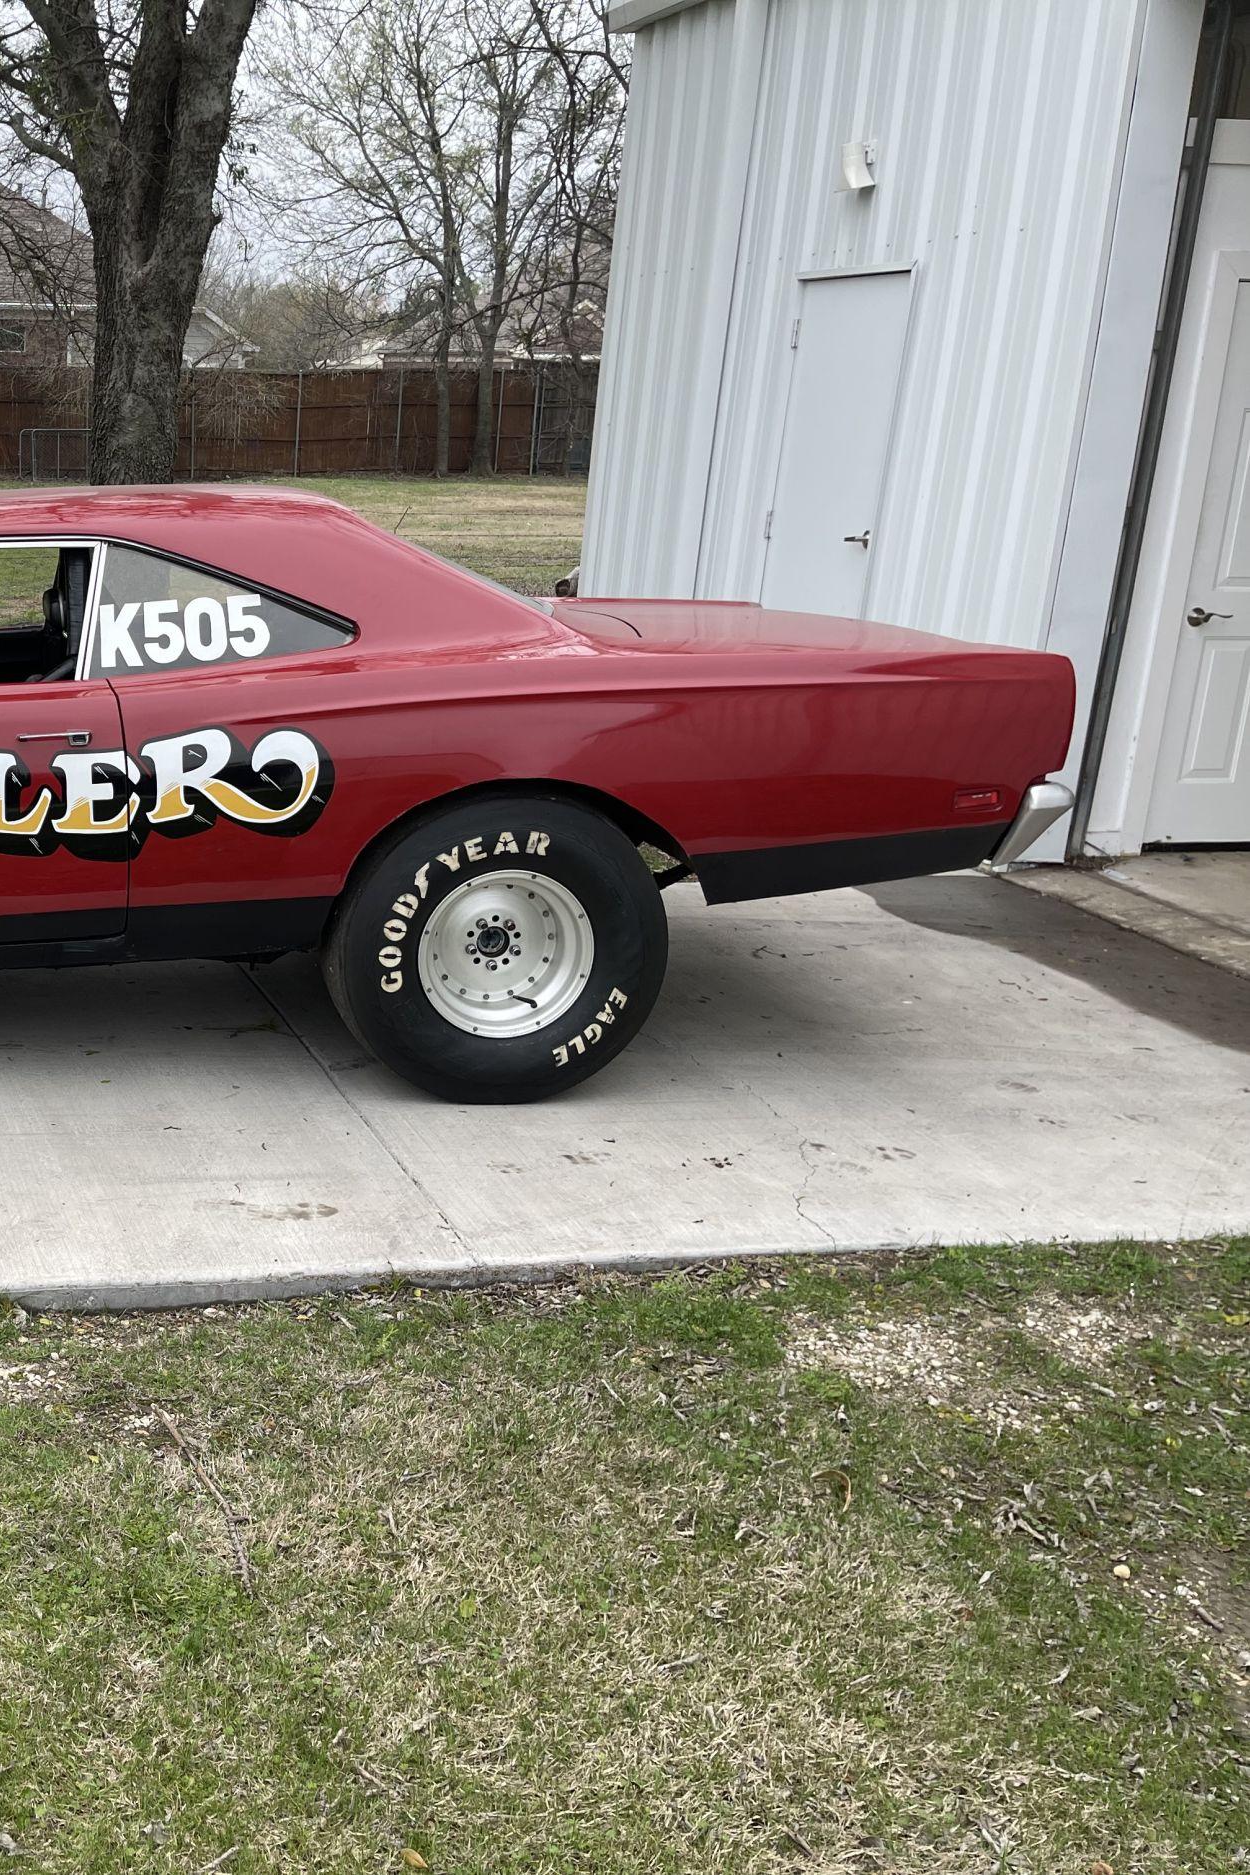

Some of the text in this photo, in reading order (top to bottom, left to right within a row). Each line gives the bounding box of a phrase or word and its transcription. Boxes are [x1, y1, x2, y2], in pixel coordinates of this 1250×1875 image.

[99, 594, 271, 668] K505
[378, 831, 551, 993] GOODYEAR
[551, 987, 628, 1067] EAGLE
